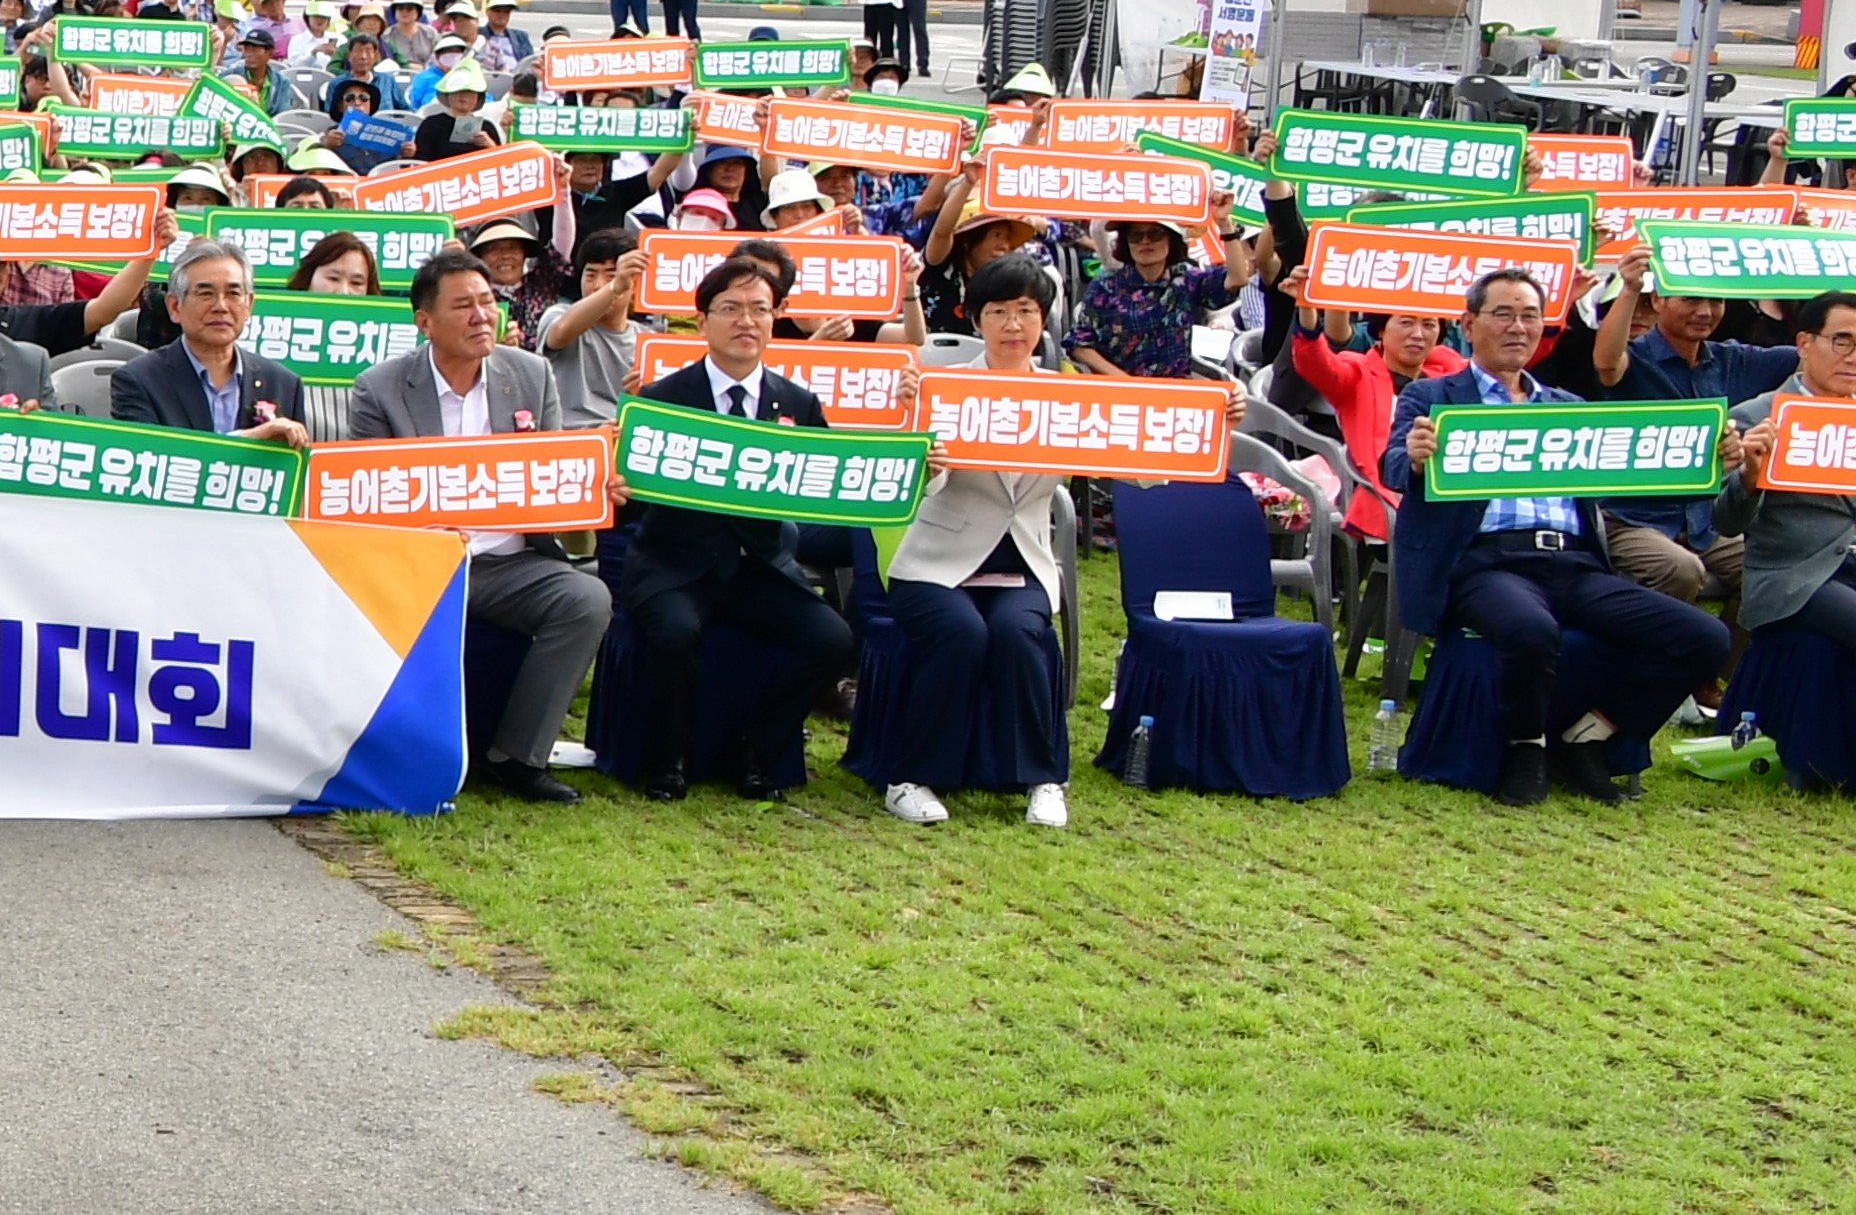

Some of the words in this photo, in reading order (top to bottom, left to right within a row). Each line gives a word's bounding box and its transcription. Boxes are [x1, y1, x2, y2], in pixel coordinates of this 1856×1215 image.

[63, 27, 111, 51] 함평군
[113, 29, 162, 53] 유치를
[164, 31, 203, 55] 희망!
[703, 52, 750, 75] 함평군
[752, 51, 801, 74] 유치를
[802, 50, 840, 73] 희망!
[551, 50, 650, 78] 농어촌기본소득
[651, 49, 687, 73] 보장!
[519, 108, 576, 135] 함평군
[580, 109, 634, 136] 유치를
[638, 109, 682, 137] 희망!
[775, 114, 905, 156] 농어촌기본소득
[906, 131, 952, 159] 보장!
[1284, 127, 1366, 166] 함평군
[1371, 135, 1444, 173] 유치를
[1449, 141, 1514, 179] 희망!
[997, 163, 1145, 203] 농어촌기본소득
[1149, 171, 1201, 206] 보장!
[86, 203, 142, 238] 보장!
[1659, 236, 1741, 276] 함평군
[928, 399, 1141, 453] 농어촌기본소득
[1143, 406, 1214, 454] 보장!
[628, 426, 733, 478] 함평군
[735, 448, 838, 497] 유치를
[842, 452, 915, 501] 희망!
[1443, 430, 1538, 473] 함평군
[1539, 427, 1633, 470] 유치를
[1634, 426, 1704, 468] 희망!
[99, 455, 201, 503] 유치를
[203, 462, 284, 514] 희망!
[320, 461, 525, 515] 농어촌기본소득
[530, 458, 595, 506] 보장!
